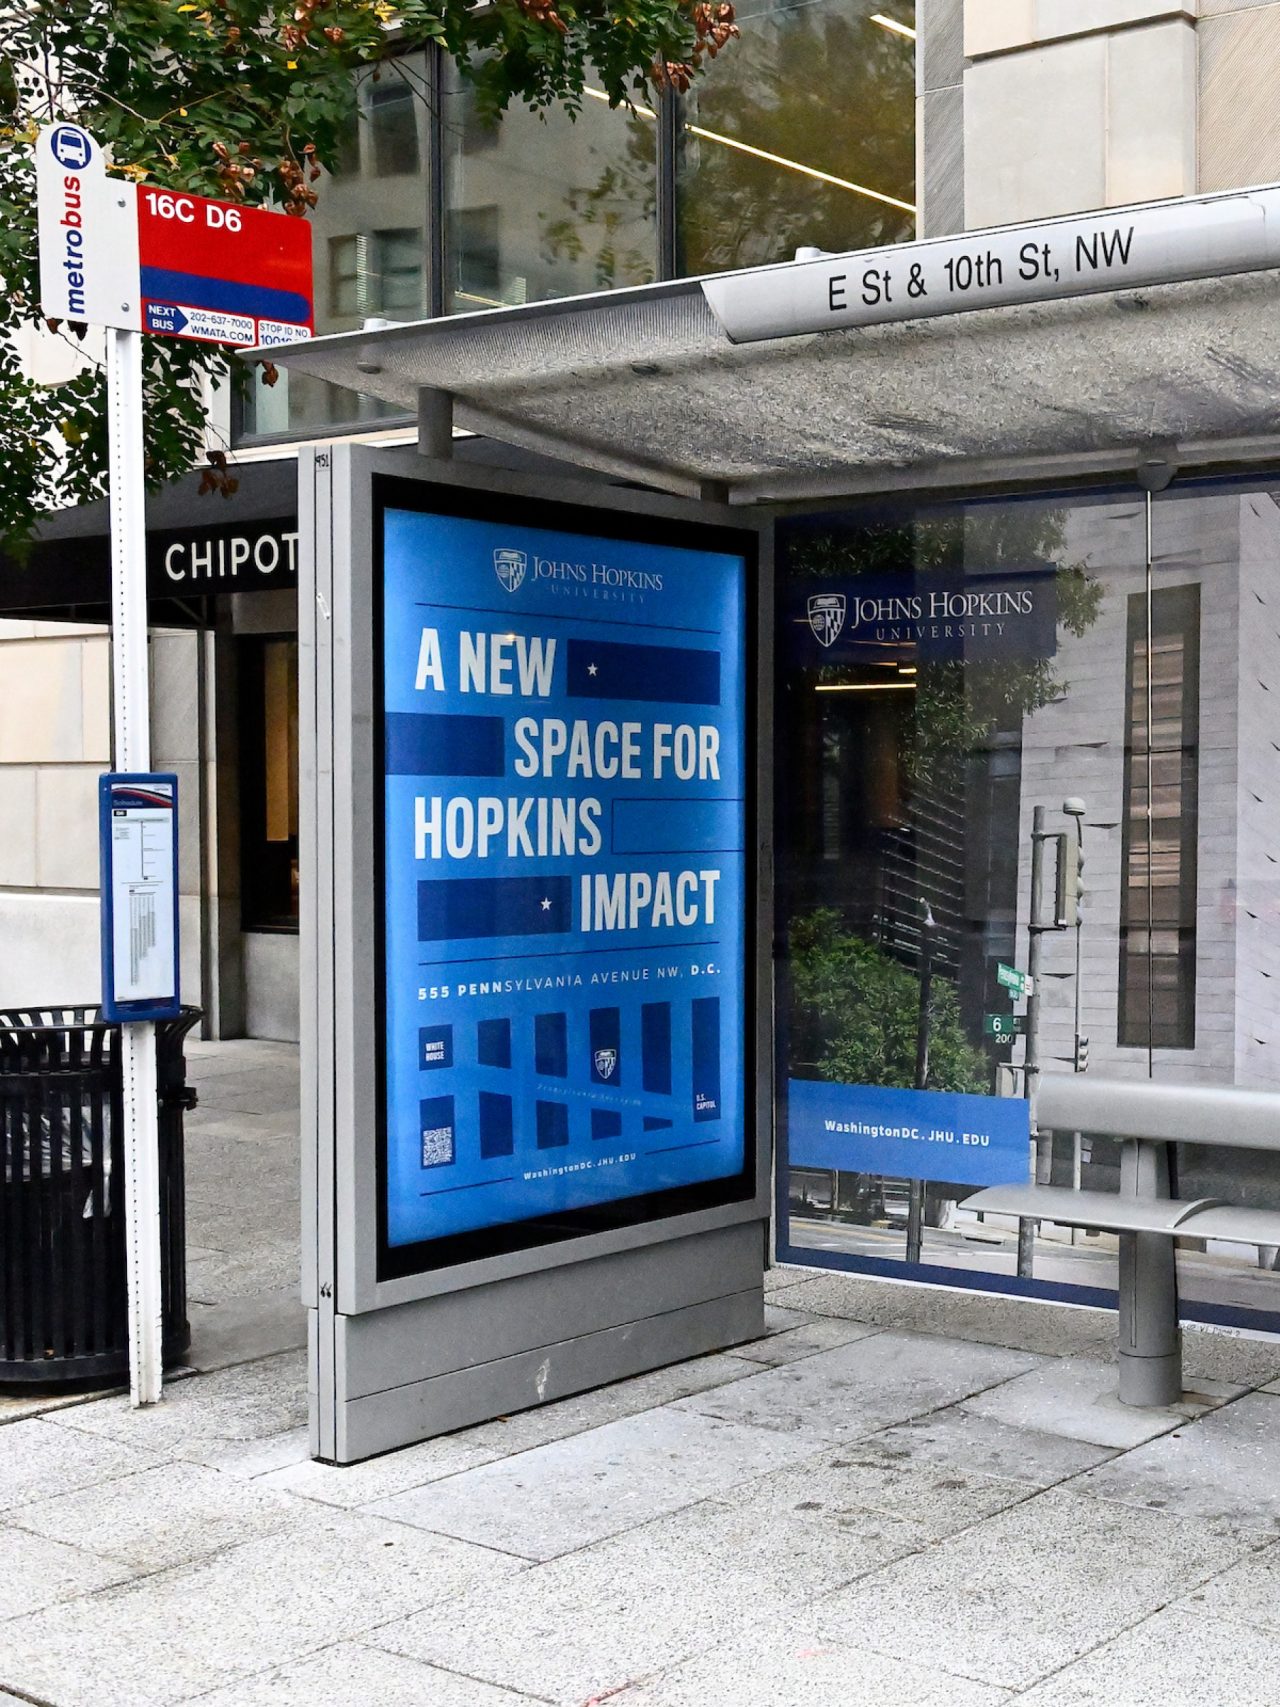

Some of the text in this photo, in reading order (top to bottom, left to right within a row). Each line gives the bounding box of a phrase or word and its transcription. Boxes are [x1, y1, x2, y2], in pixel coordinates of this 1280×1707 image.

[146, 193, 242, 232] 16C D6
[60, 176, 85, 315] metrobus
[829, 226, 1135, 311] E St & 10th St, NW
[148, 304, 177, 317] NEXT
[152, 319, 174, 330] BUS
[190, 312, 253, 330] 202-637-7000
[260, 322, 282, 333] STOP
[284, 327, 293, 335] ID
[191, 325, 253, 342] WMATA.COM
[876, 623, 1008, 641] UNIVERSITY
[415, 628, 557, 697] A NEW
[514, 716, 720, 781] SPACE FOR
[415, 797, 602, 860] HOPKINS
[580, 870, 720, 932] IMPACT
[418, 986, 451, 1000] 555
[458, 977, 583, 997] PENNSYLVANIA
[591, 968, 650, 984] AVENUE
[691, 963, 721, 976] D.C.
[992, 1017, 1002, 1032] 6
[425, 1041, 445, 1051] WHITE
[425, 1051, 445, 1061] HOUSE
[696, 1100, 716, 1111] CAPITOL
